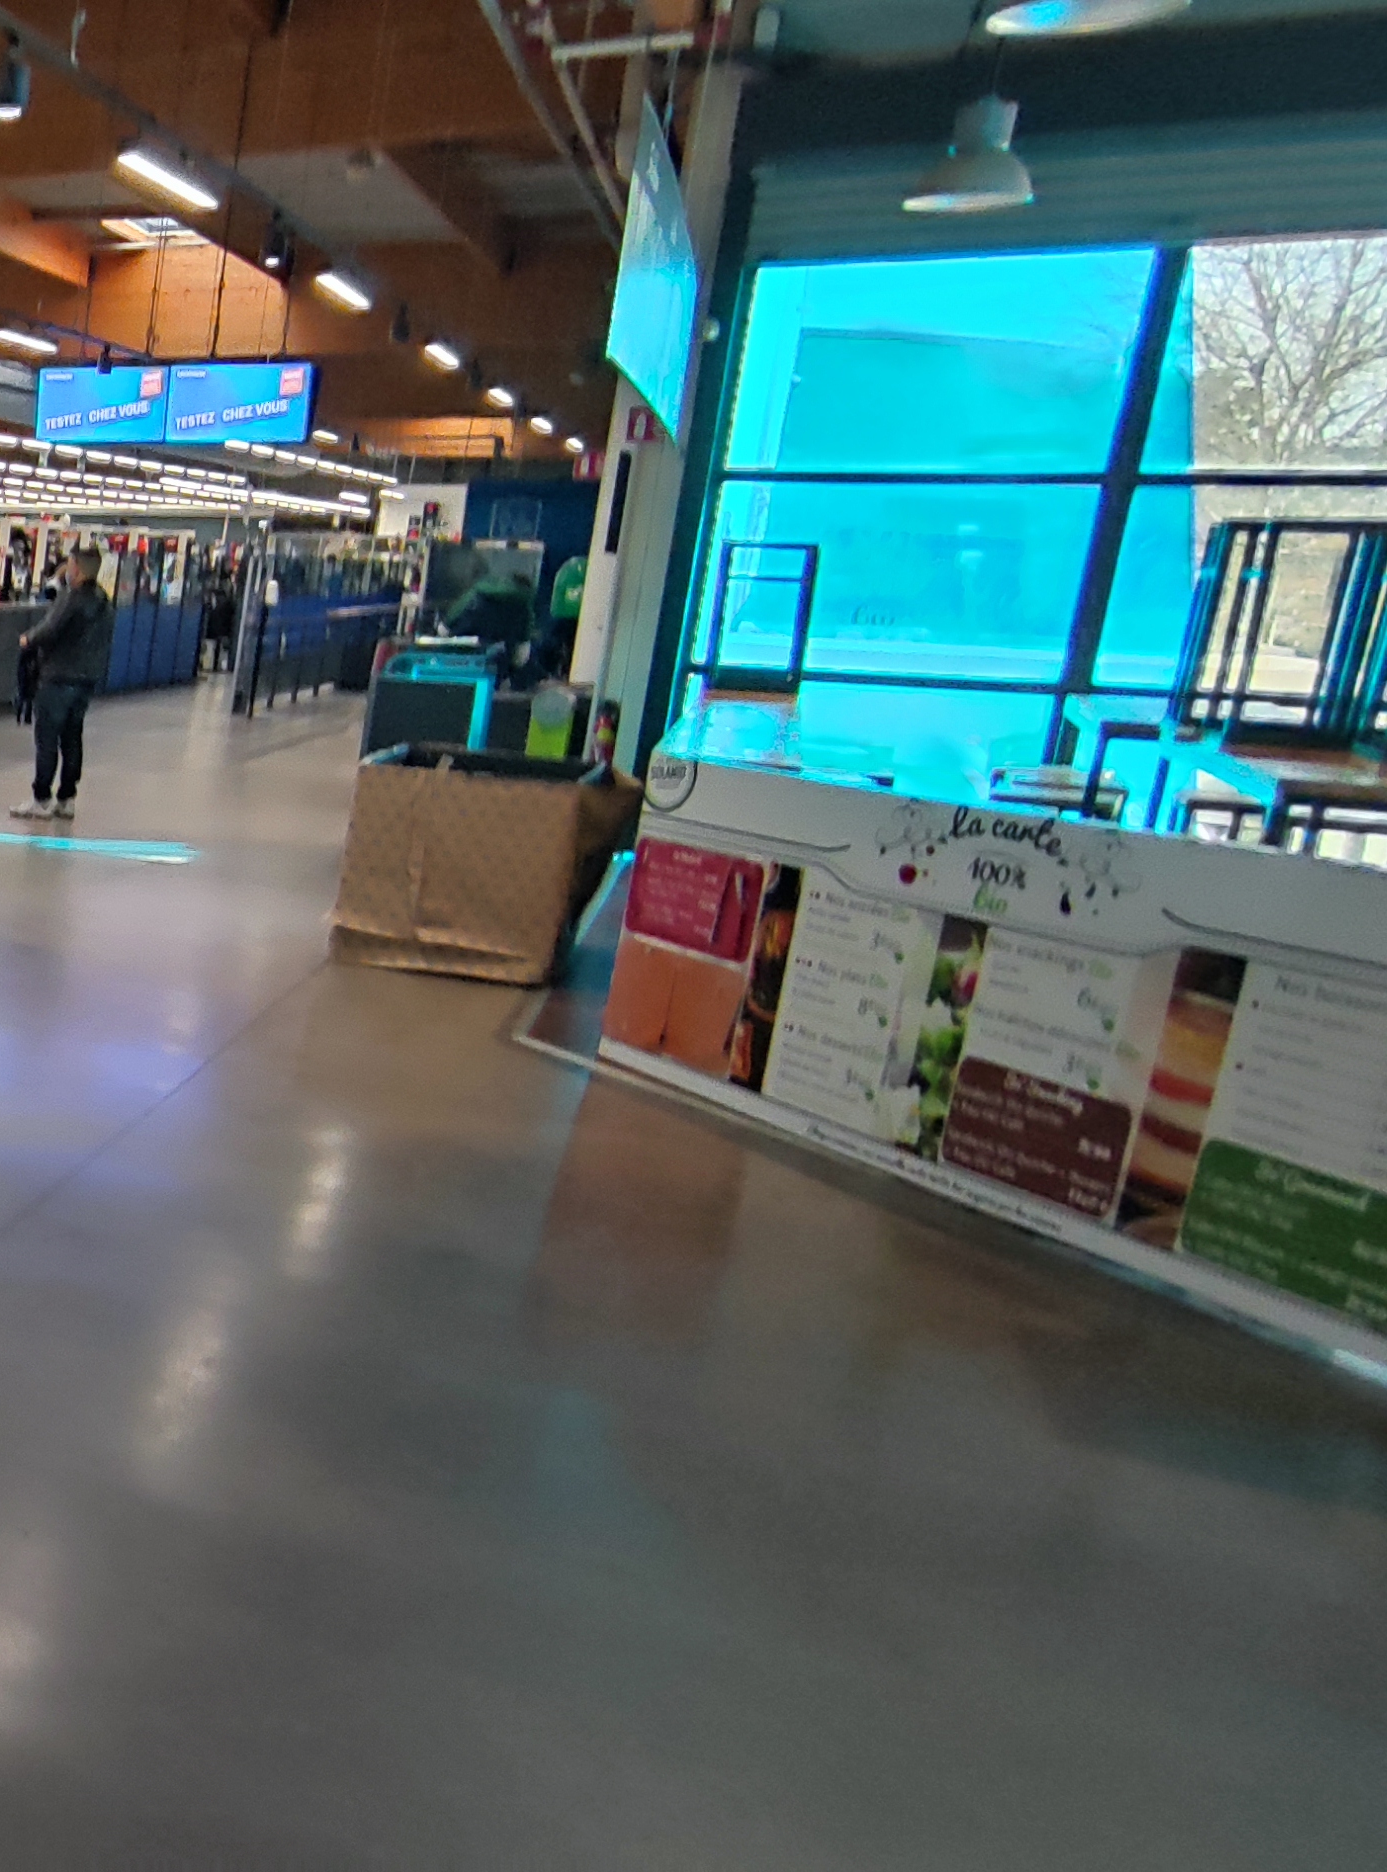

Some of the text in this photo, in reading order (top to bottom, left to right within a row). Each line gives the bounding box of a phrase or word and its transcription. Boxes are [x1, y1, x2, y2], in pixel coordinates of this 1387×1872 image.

[44, 400, 149, 430] TESTEZ CHEZ VOUS
[176, 399, 289, 430] TESTEZ CHEZ VOUS
[992, 816, 1063, 857] carte
[968, 856, 1026, 890] 100%
